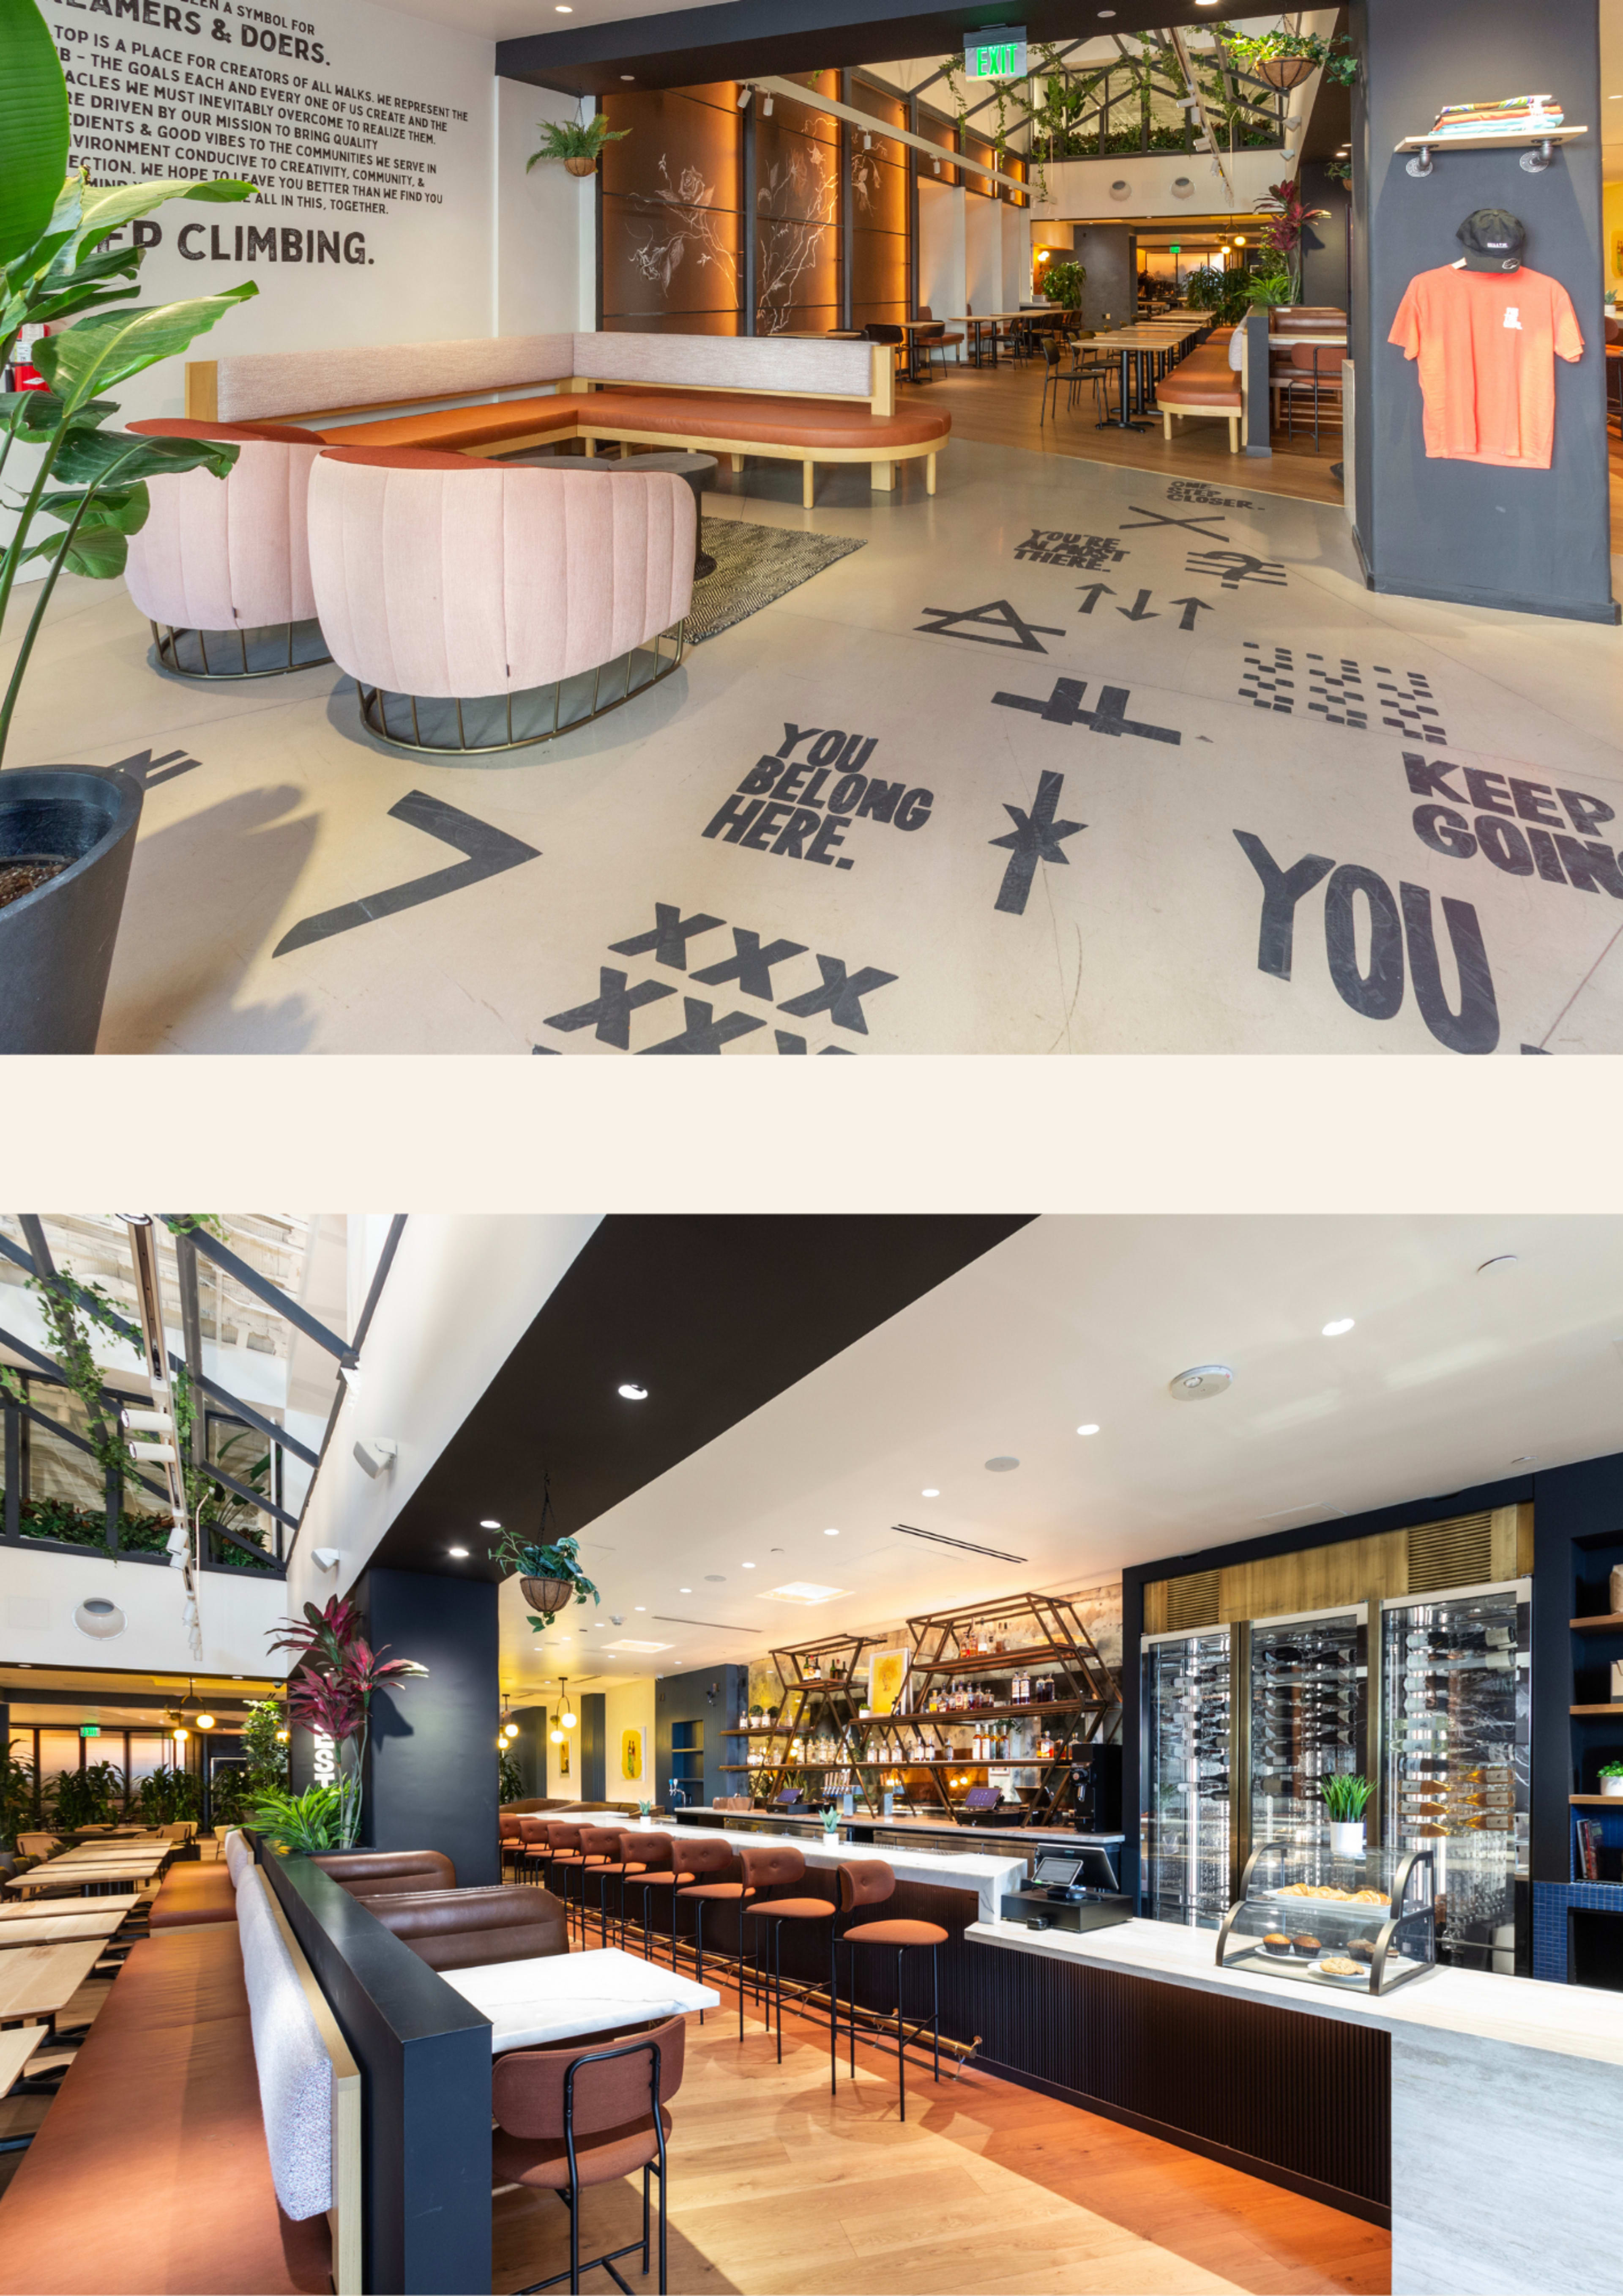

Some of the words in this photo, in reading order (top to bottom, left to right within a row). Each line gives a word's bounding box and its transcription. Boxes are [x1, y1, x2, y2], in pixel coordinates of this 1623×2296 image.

[54, 0, 201, 35] AMERS
[211, 18, 232, 44] &
[241, 23, 331, 66] DOERS.
[223, 2, 232, 14] A
[237, 5, 288, 28] SYMBOL
[291, 19, 315, 36] FOR
[50, 25, 89, 44] TOP
[94, 33, 109, 49] IS
[115, 38, 126, 53] A
[131, 41, 183, 64] PLACE
[187, 53, 216, 71] FOR
[220, 61, 289, 85] CREATORS
[293, 76, 308, 89] OF
[311, 80, 332, 94] ALL
[335, 85, 374, 102] WALKS.
[377, 93, 392, 106] WE
[394, 97, 450, 118] REPRESENT
[452, 109, 468, 122] THE
[977, 44, 1018, 77] EXIT
[63, 69, 120, 91] ACLES
[126, 80, 149, 96] WE
[154, 85, 195, 104] MUST
[199, 93, 274, 117] INEVITABLY
[278, 107, 344, 129] OVERCOME
[346, 119, 360, 131] TO
[363, 122, 406, 140] REALIZE
[408, 130, 435, 144] THEM.
[90, 53, 123, 72] THE
[128, 61, 180, 82] GOALS
[185, 72, 224, 91] EACH
[228, 81, 257, 96] AND
[260, 86, 301, 104] EVERY
[304, 95, 329, 110] ONE
[332, 101, 346, 113] OF
[349, 104, 363, 116] US
[366, 107, 405, 124] CREATE
[408, 115, 429, 128] AND
[430, 120, 447, 132] THE
[69, 112, 134, 134] DIENTS
[140, 123, 152, 137] &
[157, 125, 201, 142] GOOD
[205, 131, 246, 148] VIBES
[249, 138, 265, 151] TO
[269, 140, 292, 155] THE
[296, 145, 373, 165] COMMUNITIES
[376, 156, 391, 168] WE
[393, 159, 424, 173] SERVE
[427, 164, 437, 174] IN
[91, 95, 153, 117] DRIVEN
[158, 105, 176, 120] BY
[181, 109, 212, 126] OUR
[216, 115, 271, 134] MISSION
[275, 124, 291, 137] TO
[294, 127, 330, 143] BRING
[333, 134, 378, 150] QUALITY
[69, 134, 171, 158] VIRONMENT
[175, 147, 257, 168] CONDUCIVE
[261, 157, 277, 170] TO
[280, 160, 350, 180] CREATIVITY,
[352, 169, 414, 187] COMMUNITY,
[417, 178, 425, 187] &
[141, 162, 163, 177] WE
[168, 165, 208, 181] HOPE
[212, 170, 230, 180] TO
[279, 176, 303, 190] YOU
[306, 180, 349, 194] BETTER
[352, 185, 380, 198] THAN
[383, 188, 398, 200] WE
[400, 190, 422, 202] FIND
[424, 192, 443, 204] YOU
[255, 192, 277, 205] ALL
[281, 194, 293, 206] IN
[297, 196, 326, 210] THIS,
[330, 199, 388, 214] TOGETHER.
[177, 223, 374, 265] CLIMBING.
[1014, 548, 1111, 572] THERE.
[1016, 539, 1131, 562] ALMOST
[775, 722, 879, 774] YOU
[736, 755, 934, 832] BELONG
[1401, 750, 1615, 837] KEEP
[701, 793, 855, 870] HERE.
[1412, 803, 1623, 900] GOIN
[1232, 828, 1501, 1054] YOU
